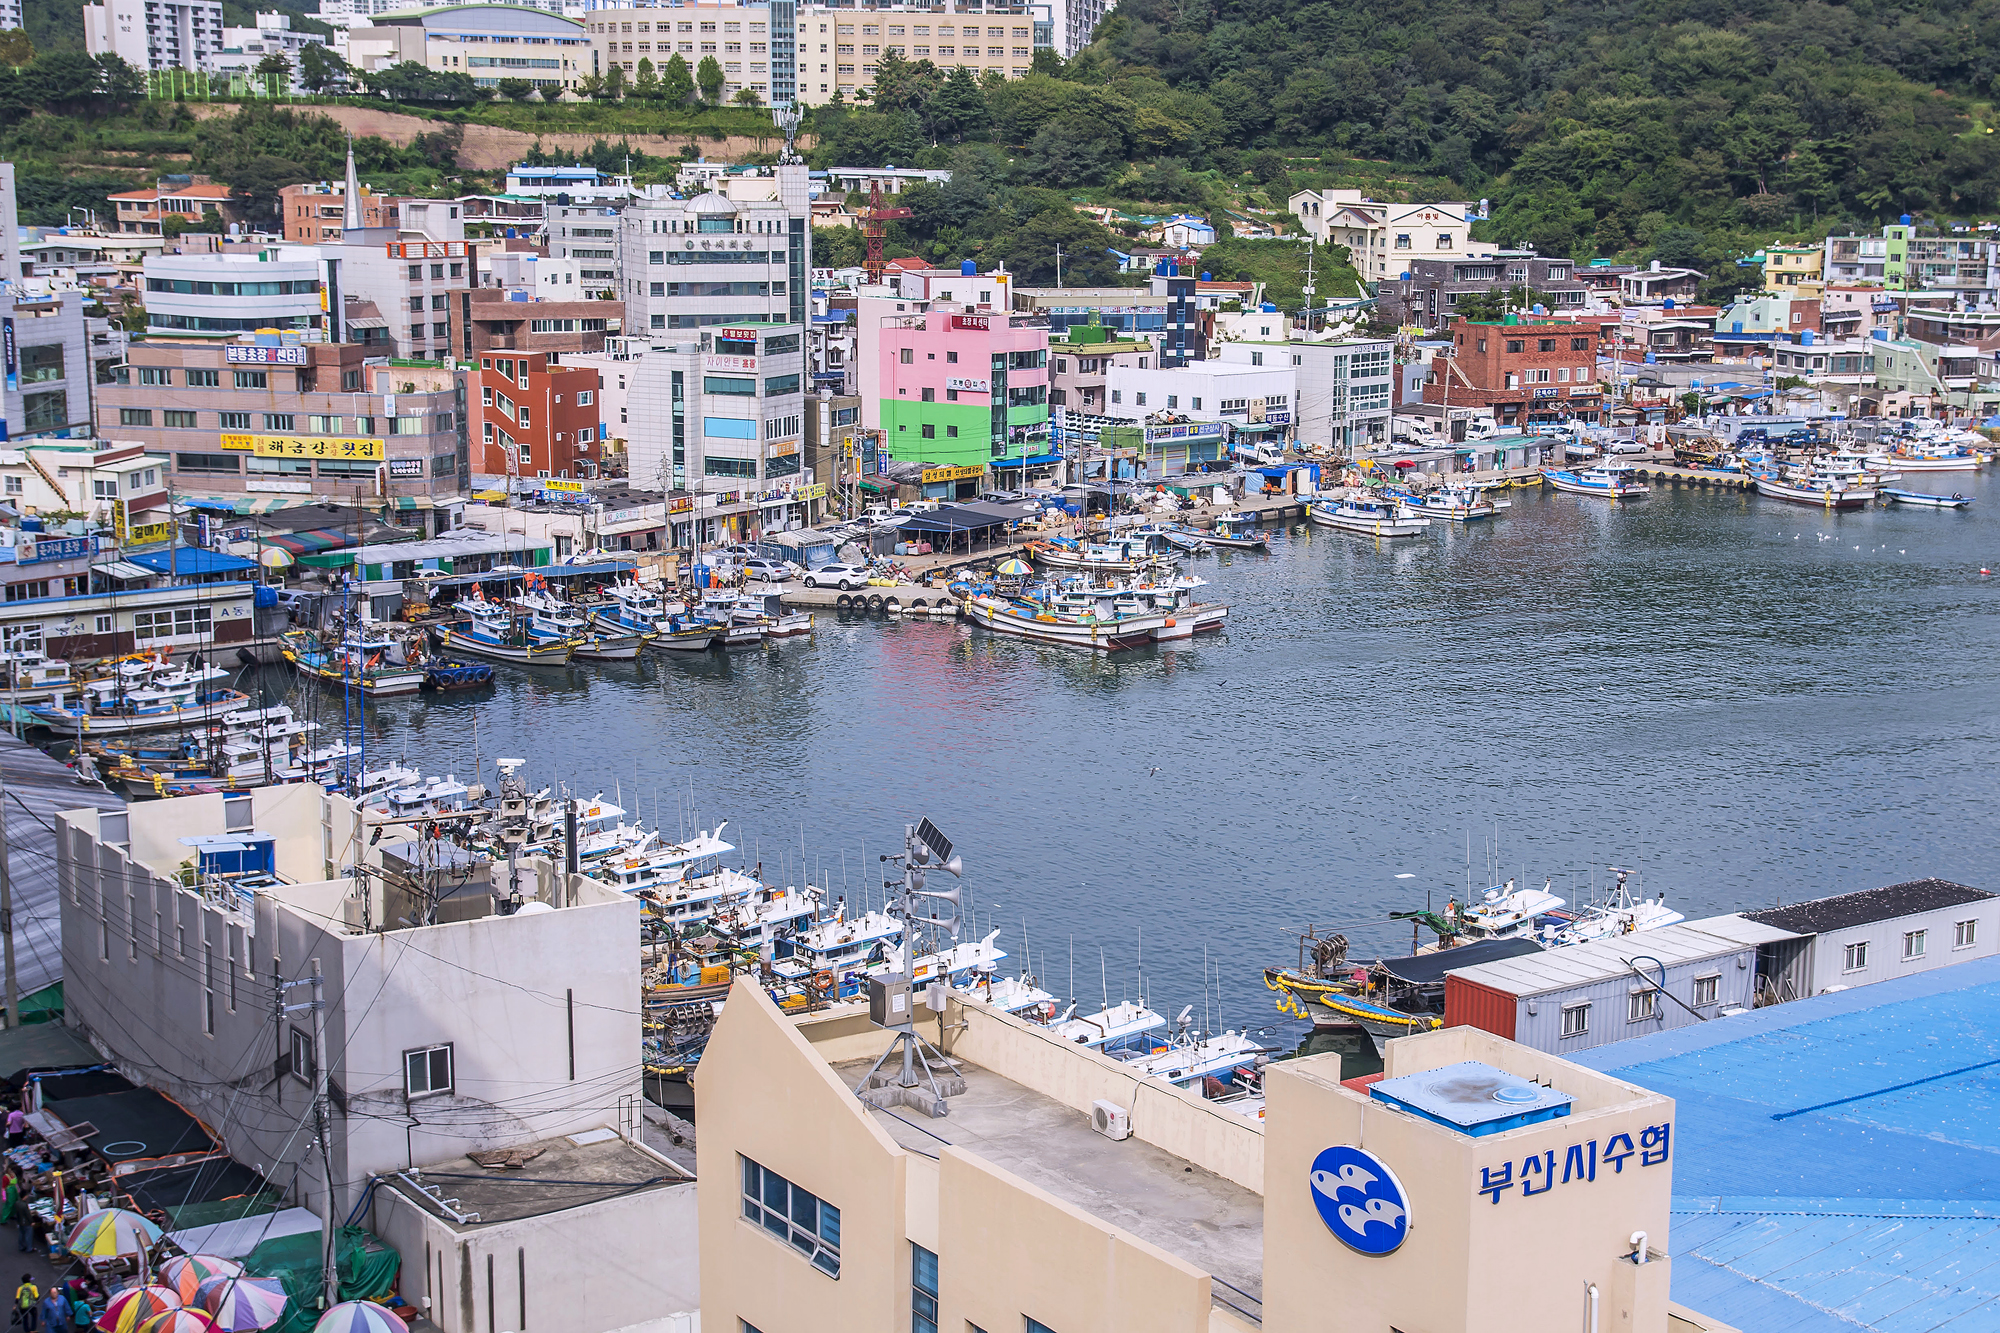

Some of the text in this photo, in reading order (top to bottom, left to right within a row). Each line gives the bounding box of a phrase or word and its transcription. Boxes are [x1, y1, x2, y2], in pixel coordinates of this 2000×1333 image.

[340, 442, 374, 457] 횟집
[134, 523, 165, 539] 갈매기
[1477, 1122, 1671, 1205] 부산시수협
